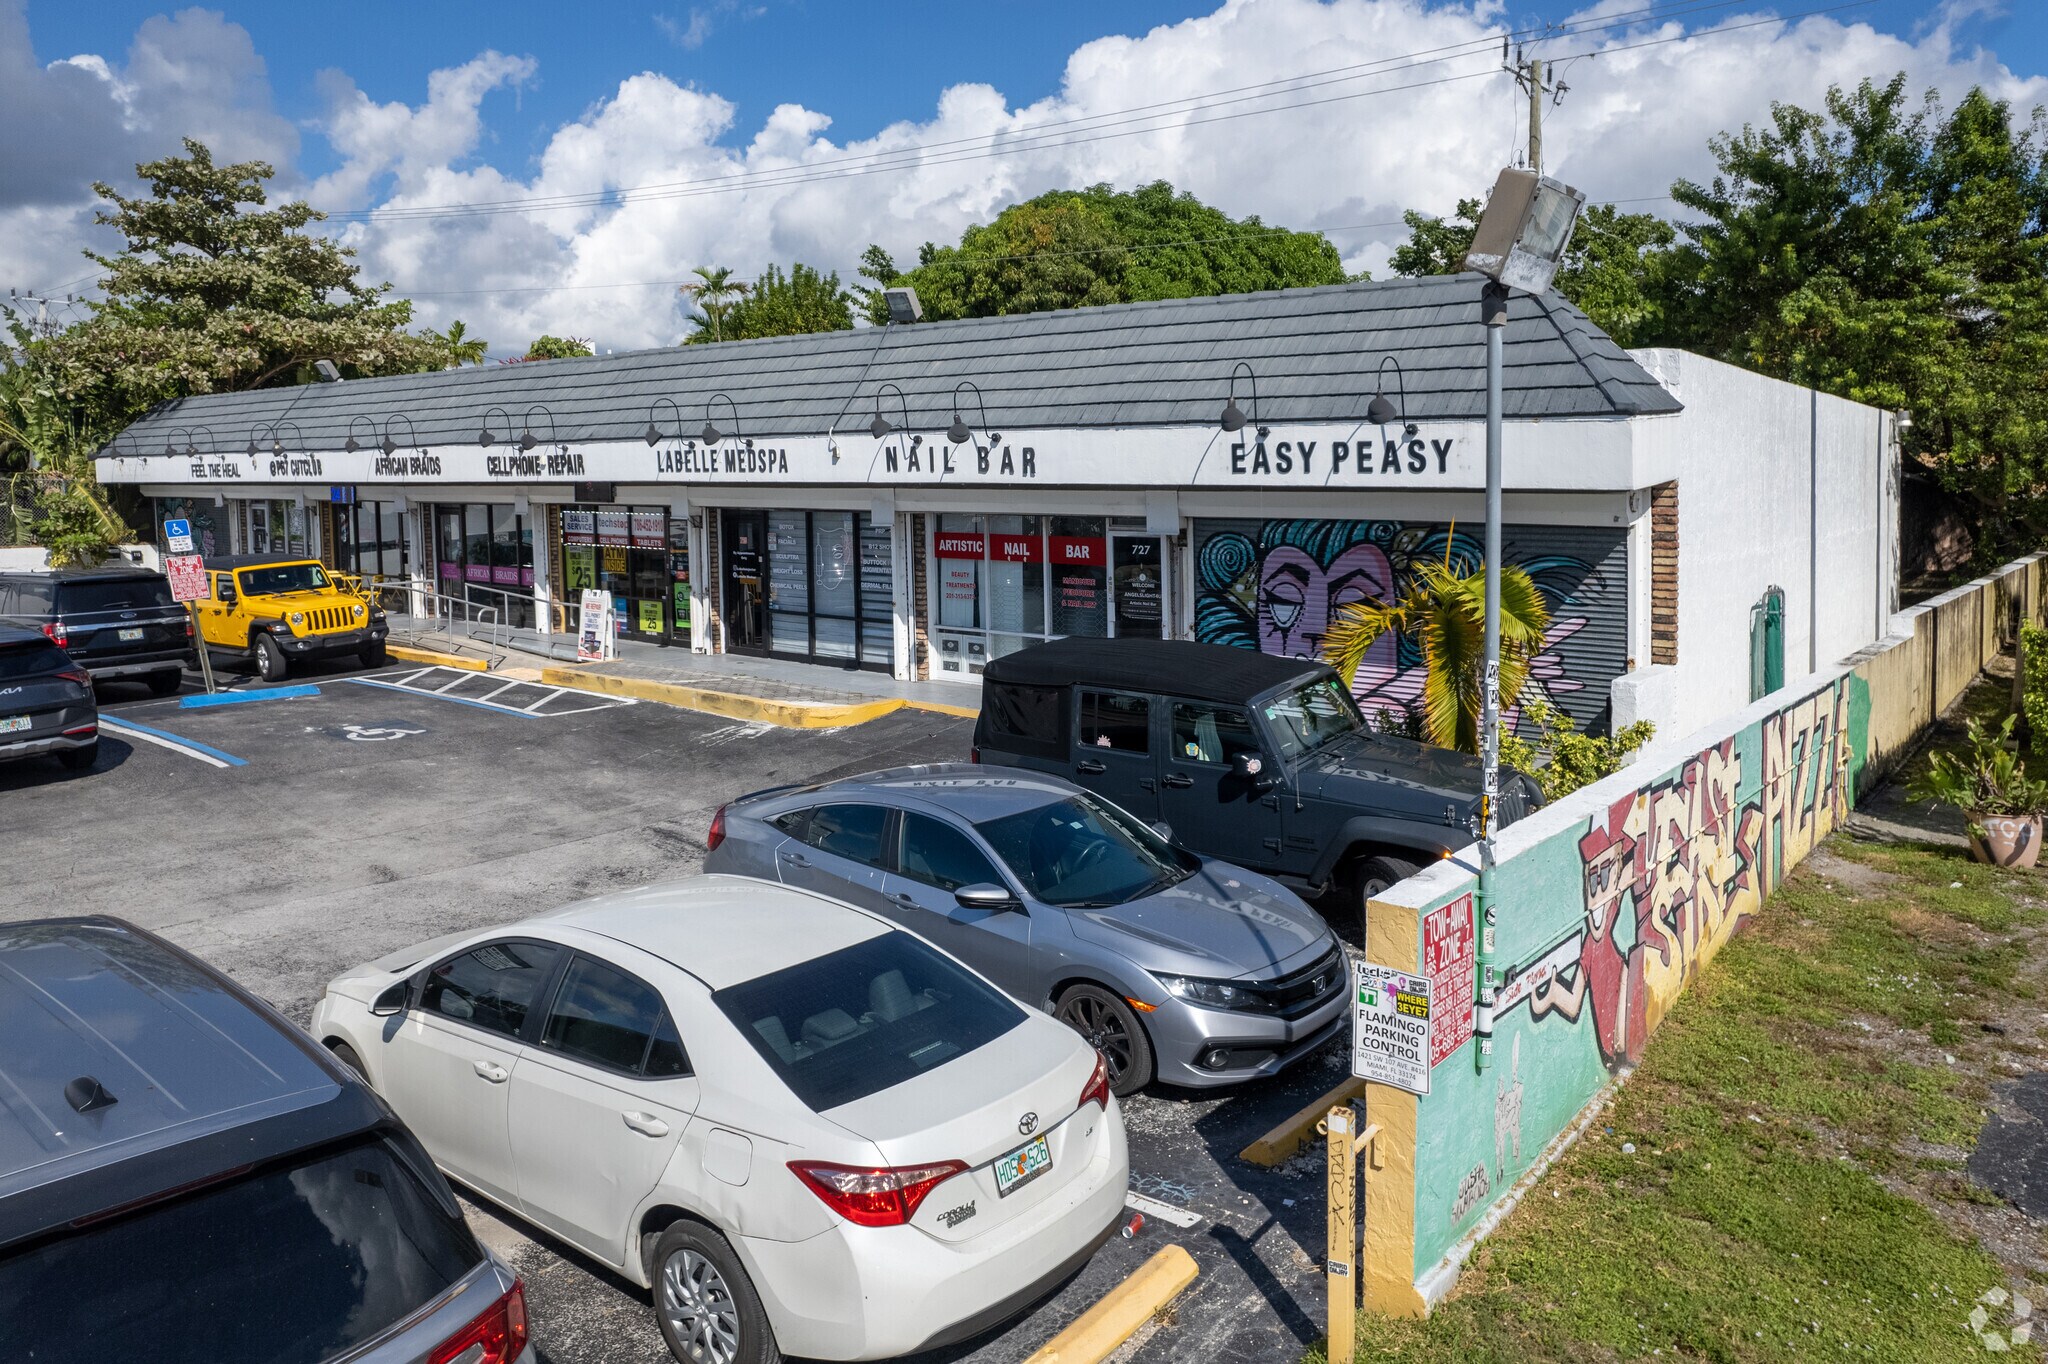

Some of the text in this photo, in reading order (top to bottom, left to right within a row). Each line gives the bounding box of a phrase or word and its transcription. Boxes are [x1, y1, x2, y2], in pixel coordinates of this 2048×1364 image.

[657, 449, 788, 474] LABELLE MEDSPA
[885, 446, 1037, 478] NAIL BAR
[1231, 438, 1454, 475] EASY PEASY
[191, 463, 241, 478] FEEL THE HEAL
[375, 457, 442, 476] AFRICAN BRAIDS
[487, 454, 586, 477] CELLPHONE REPAIR
[567, 523, 592, 531] SERVICE
[637, 539, 662, 547] TABLETS
[938, 539, 983, 553] ARTISTIC
[1004, 542, 1030, 556] NAIL
[1131, 545, 1151, 555] 727
[604, 547, 624, 558] ATM
[1065, 544, 1090, 558] BAR
[466, 568, 490, 578] AFRICAN
[604, 560, 625, 573] INSIDE
[495, 570, 518, 581] BRAIDS
[1062, 577, 1096, 586] MANICURE
[1062, 588, 1095, 598] PEDICURE
[1427, 896, 1468, 944] TOW-AWAY
[1426, 944, 1436, 963] 24
[1439, 930, 1461, 969] ZONE
[1465, 924, 1470, 940] 7
[1396, 992, 1428, 1007] WHERE
[1397, 1002, 1428, 1017] 3EYE7
[1359, 1009, 1426, 1036] FLAMINGO
[1365, 1024, 1419, 1048] PARKING
[1431, 1019, 1471, 1061] 05-688-5919
[1362, 1037, 1421, 1062] CONTROL
[1357, 1051, 1372, 1060] 1421
[1373, 1054, 1383, 1063] SW
[1385, 1057, 1396, 1066] 107
[1366, 1061, 1416, 1080] MIAMI, FL 33174
[1370, 1069, 1412, 1087] 954-851-4802
[997, 1157, 1019, 1186] HDS
[936, 1199, 976, 1222] COROLLA
